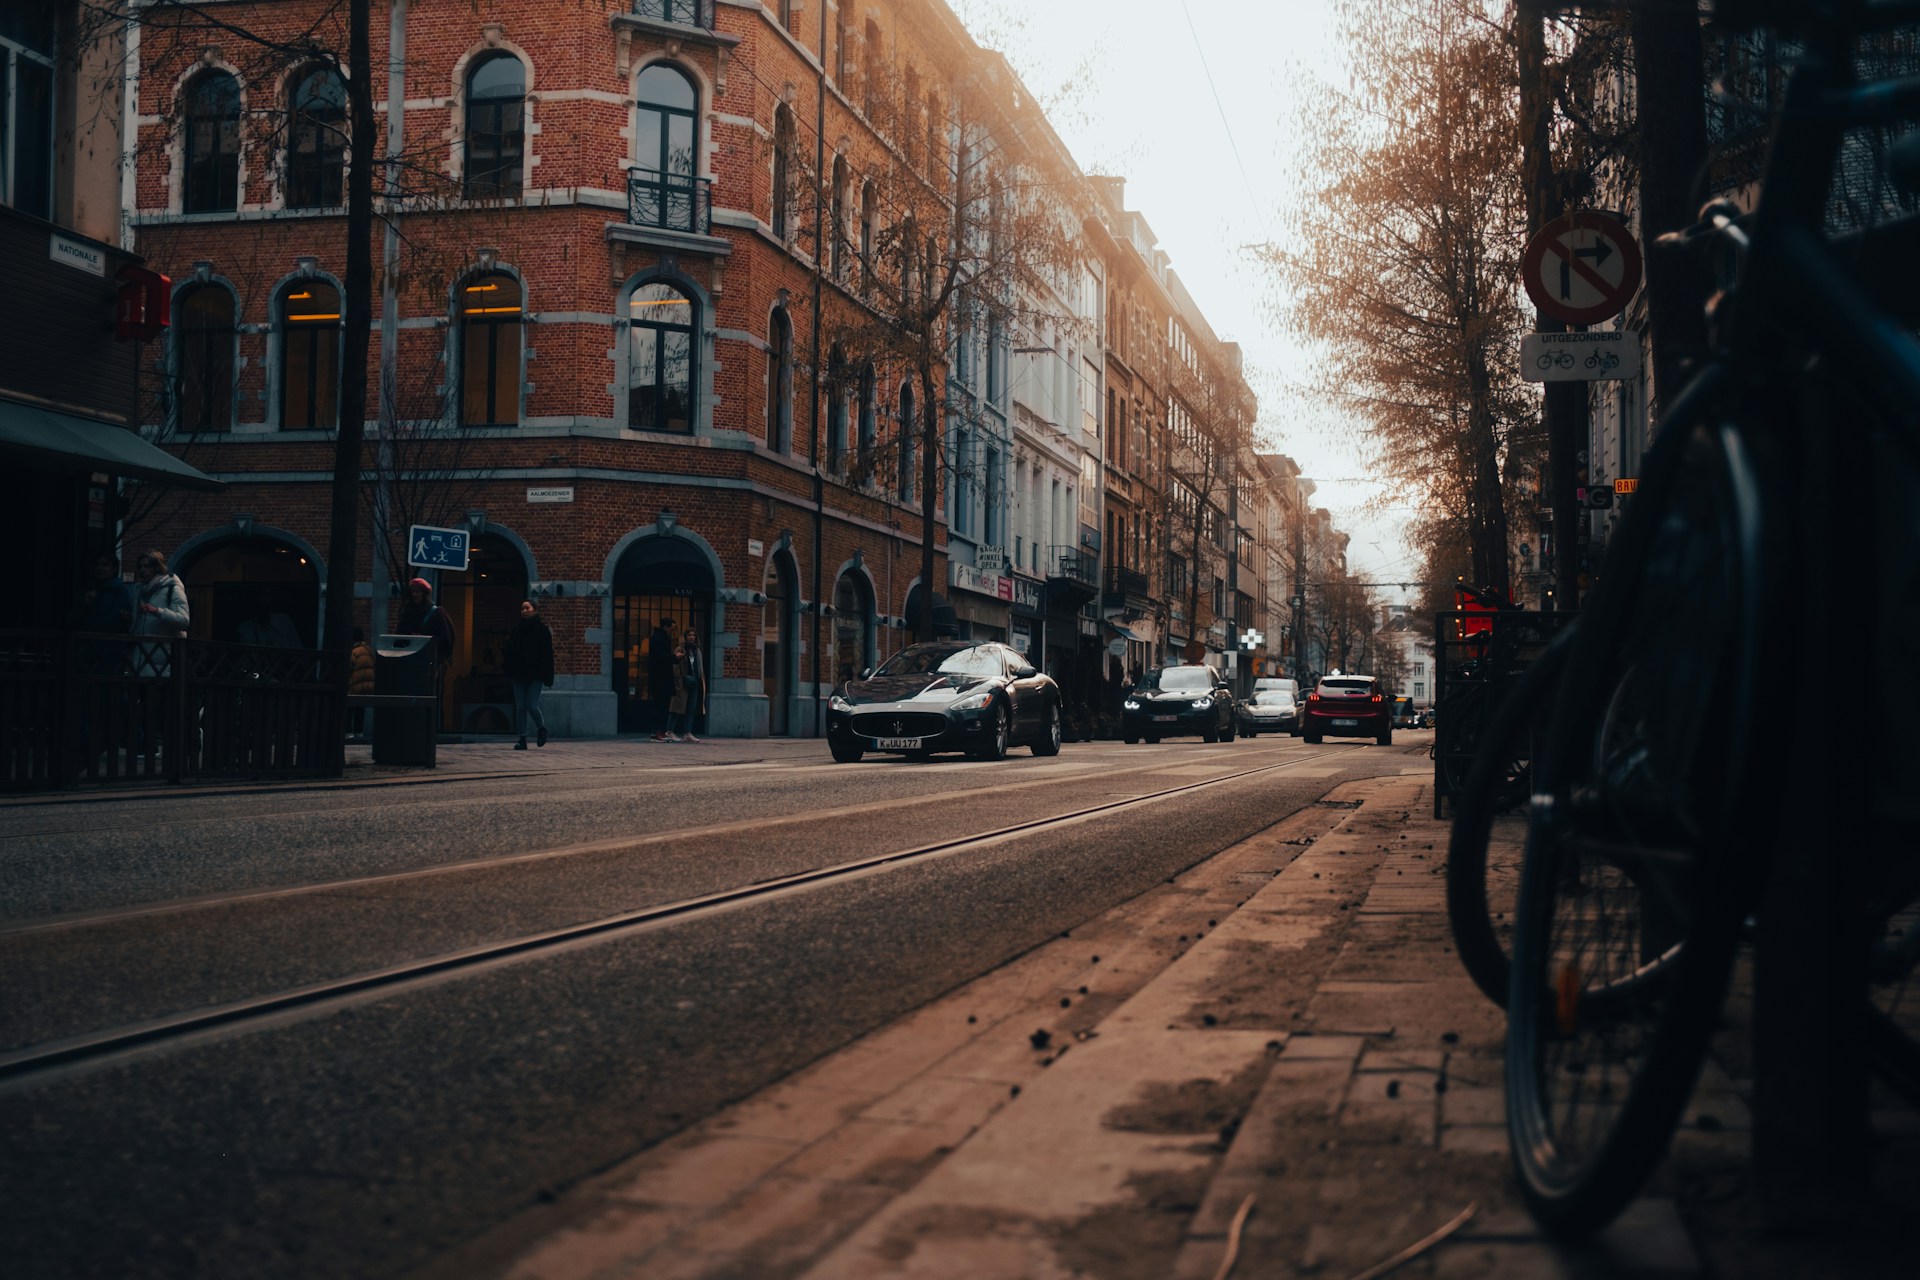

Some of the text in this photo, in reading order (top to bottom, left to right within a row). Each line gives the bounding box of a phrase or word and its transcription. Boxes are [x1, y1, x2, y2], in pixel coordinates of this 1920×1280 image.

[58, 243, 98, 264] NATIONALE
[1541, 332, 1622, 344] UITGEZONDERD
[979, 545, 1002, 554] NACHT
[979, 553, 1001, 562] WINKEL
[981, 561, 997, 569] OPEN
